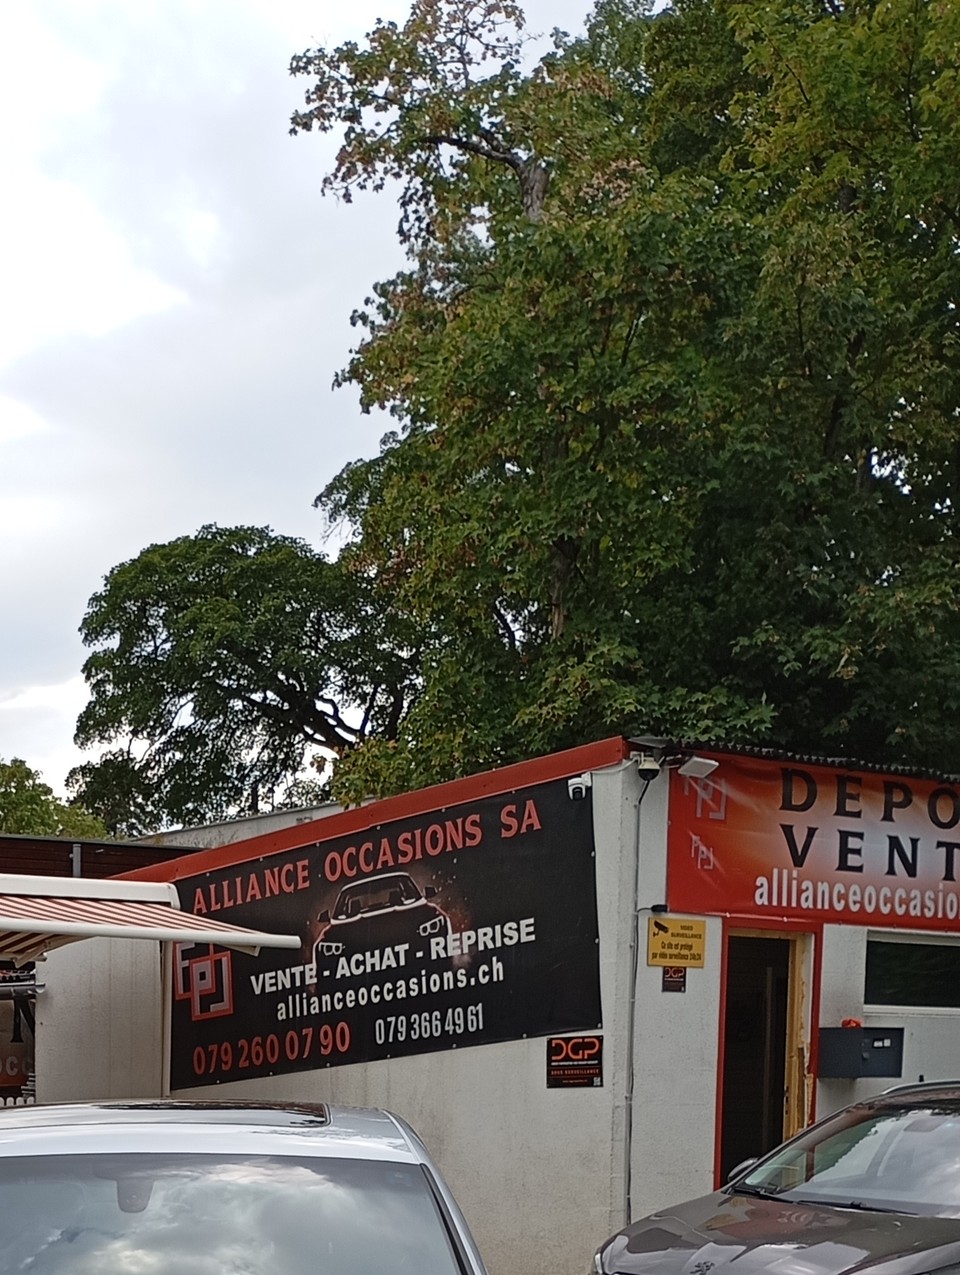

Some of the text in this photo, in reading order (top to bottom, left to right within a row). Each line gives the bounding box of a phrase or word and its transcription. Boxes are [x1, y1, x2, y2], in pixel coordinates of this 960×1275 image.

[193, 800, 541, 914] ALLIANCE OCCASIONS SA
[780, 824, 960, 881] VENT
[755, 868, 960, 920] allianceoccasio
[250, 963, 317, 995] VENTE
[336, 943, 409, 979] ACHAT
[431, 918, 536, 960] REPRISE
[277, 956, 504, 1021] allianceoccasions.ch
[193, 1021, 351, 1075] 079 260 07 90
[375, 1002, 484, 1045] 079 366 49 61
[551, 1038, 599, 1060] DGP
